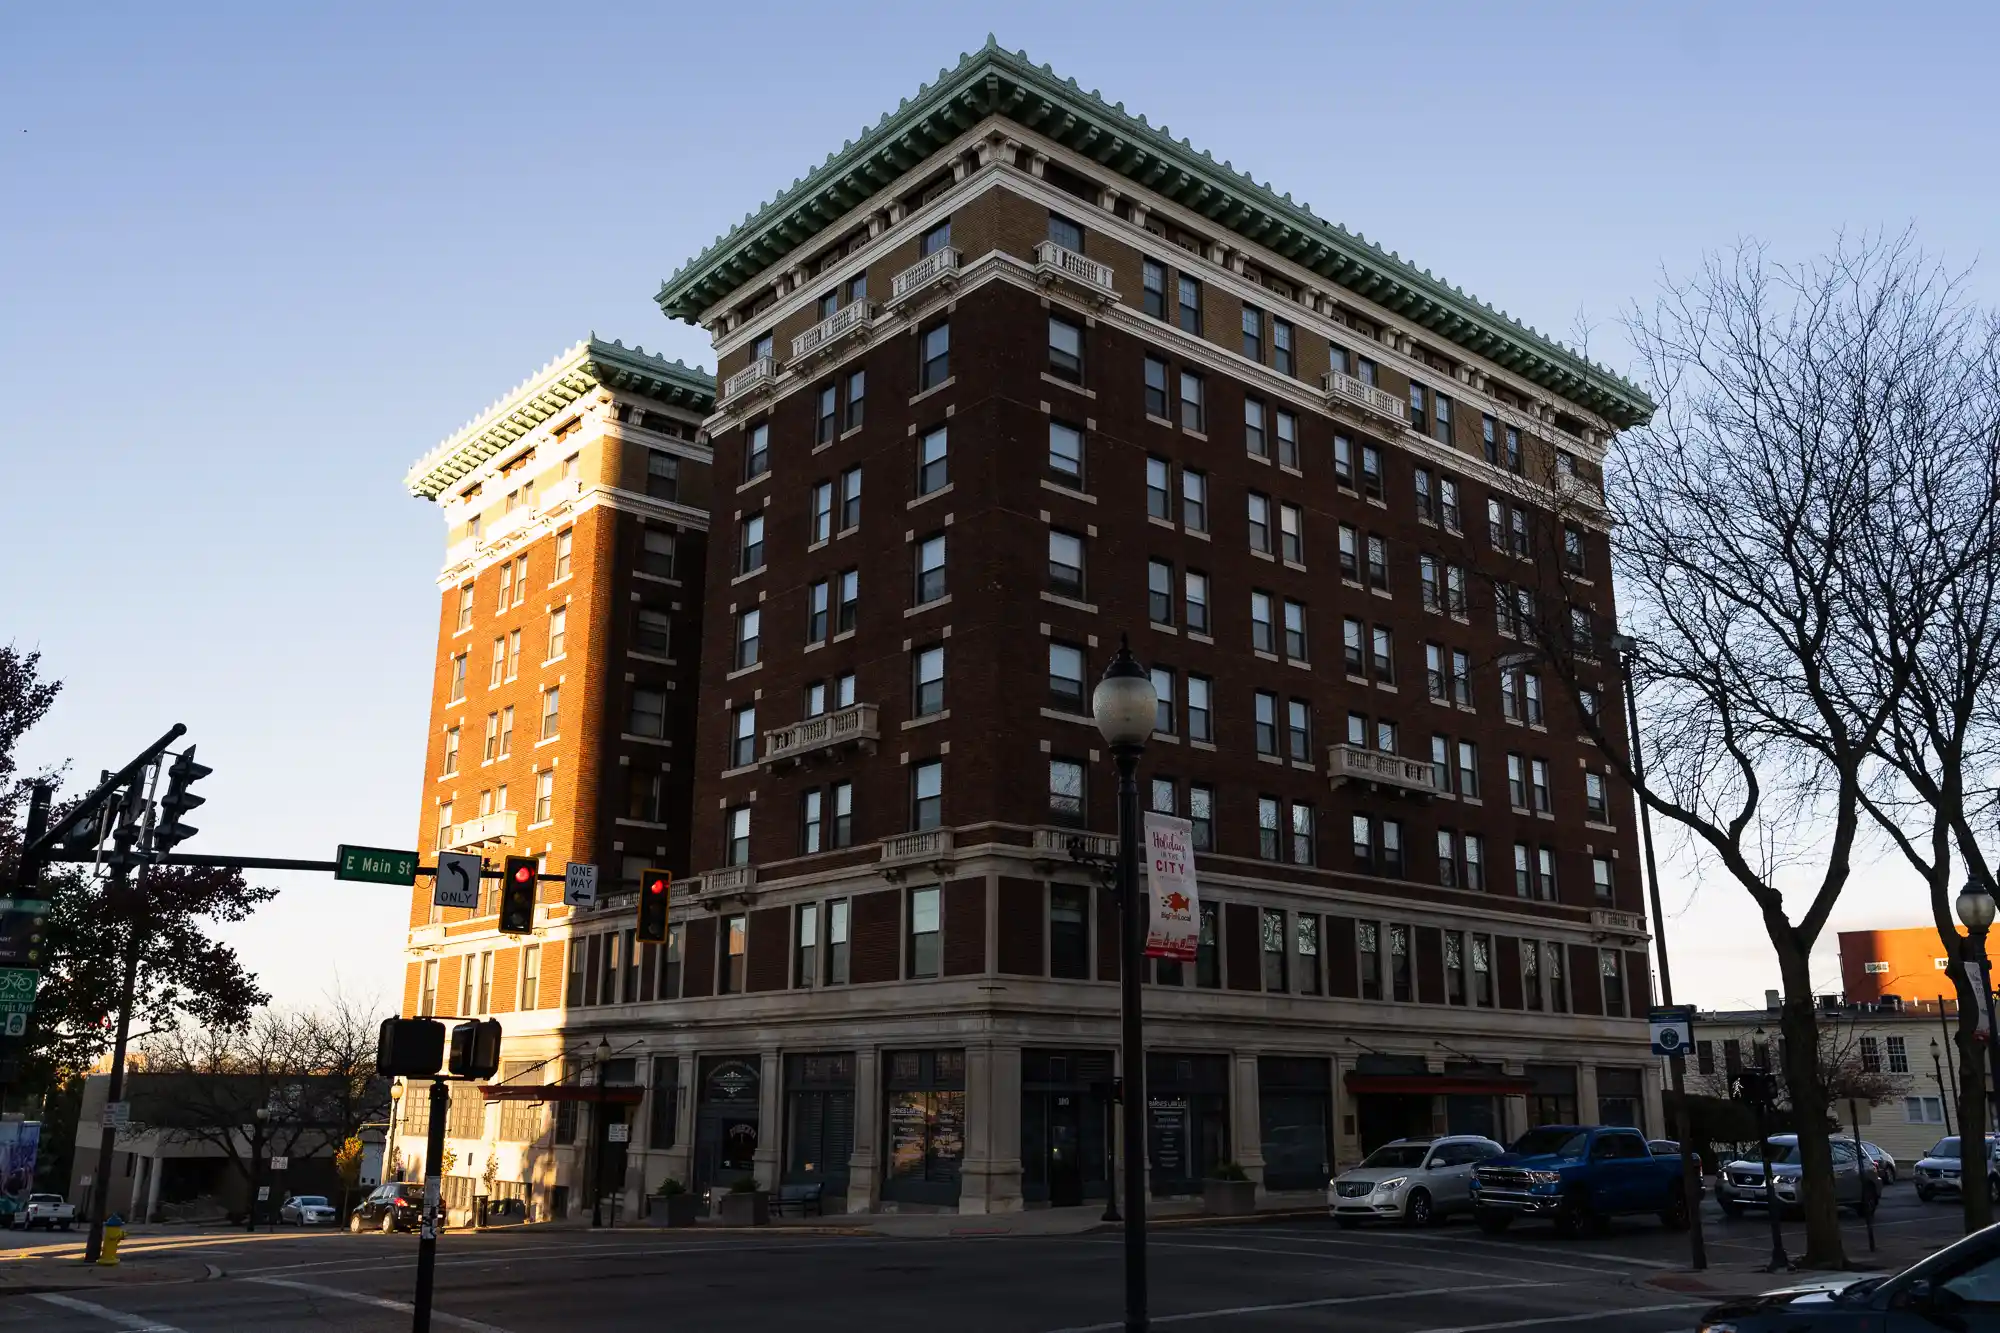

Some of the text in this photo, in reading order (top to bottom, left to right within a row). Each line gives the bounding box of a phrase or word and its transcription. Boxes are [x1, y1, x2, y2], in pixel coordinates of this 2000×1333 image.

[346, 855, 412, 875] E Main St
[571, 865, 593, 877] ONE
[1156, 859, 1185, 875] CITY
[570, 877, 593, 889] WAY
[441, 891, 473, 904] ONLY
